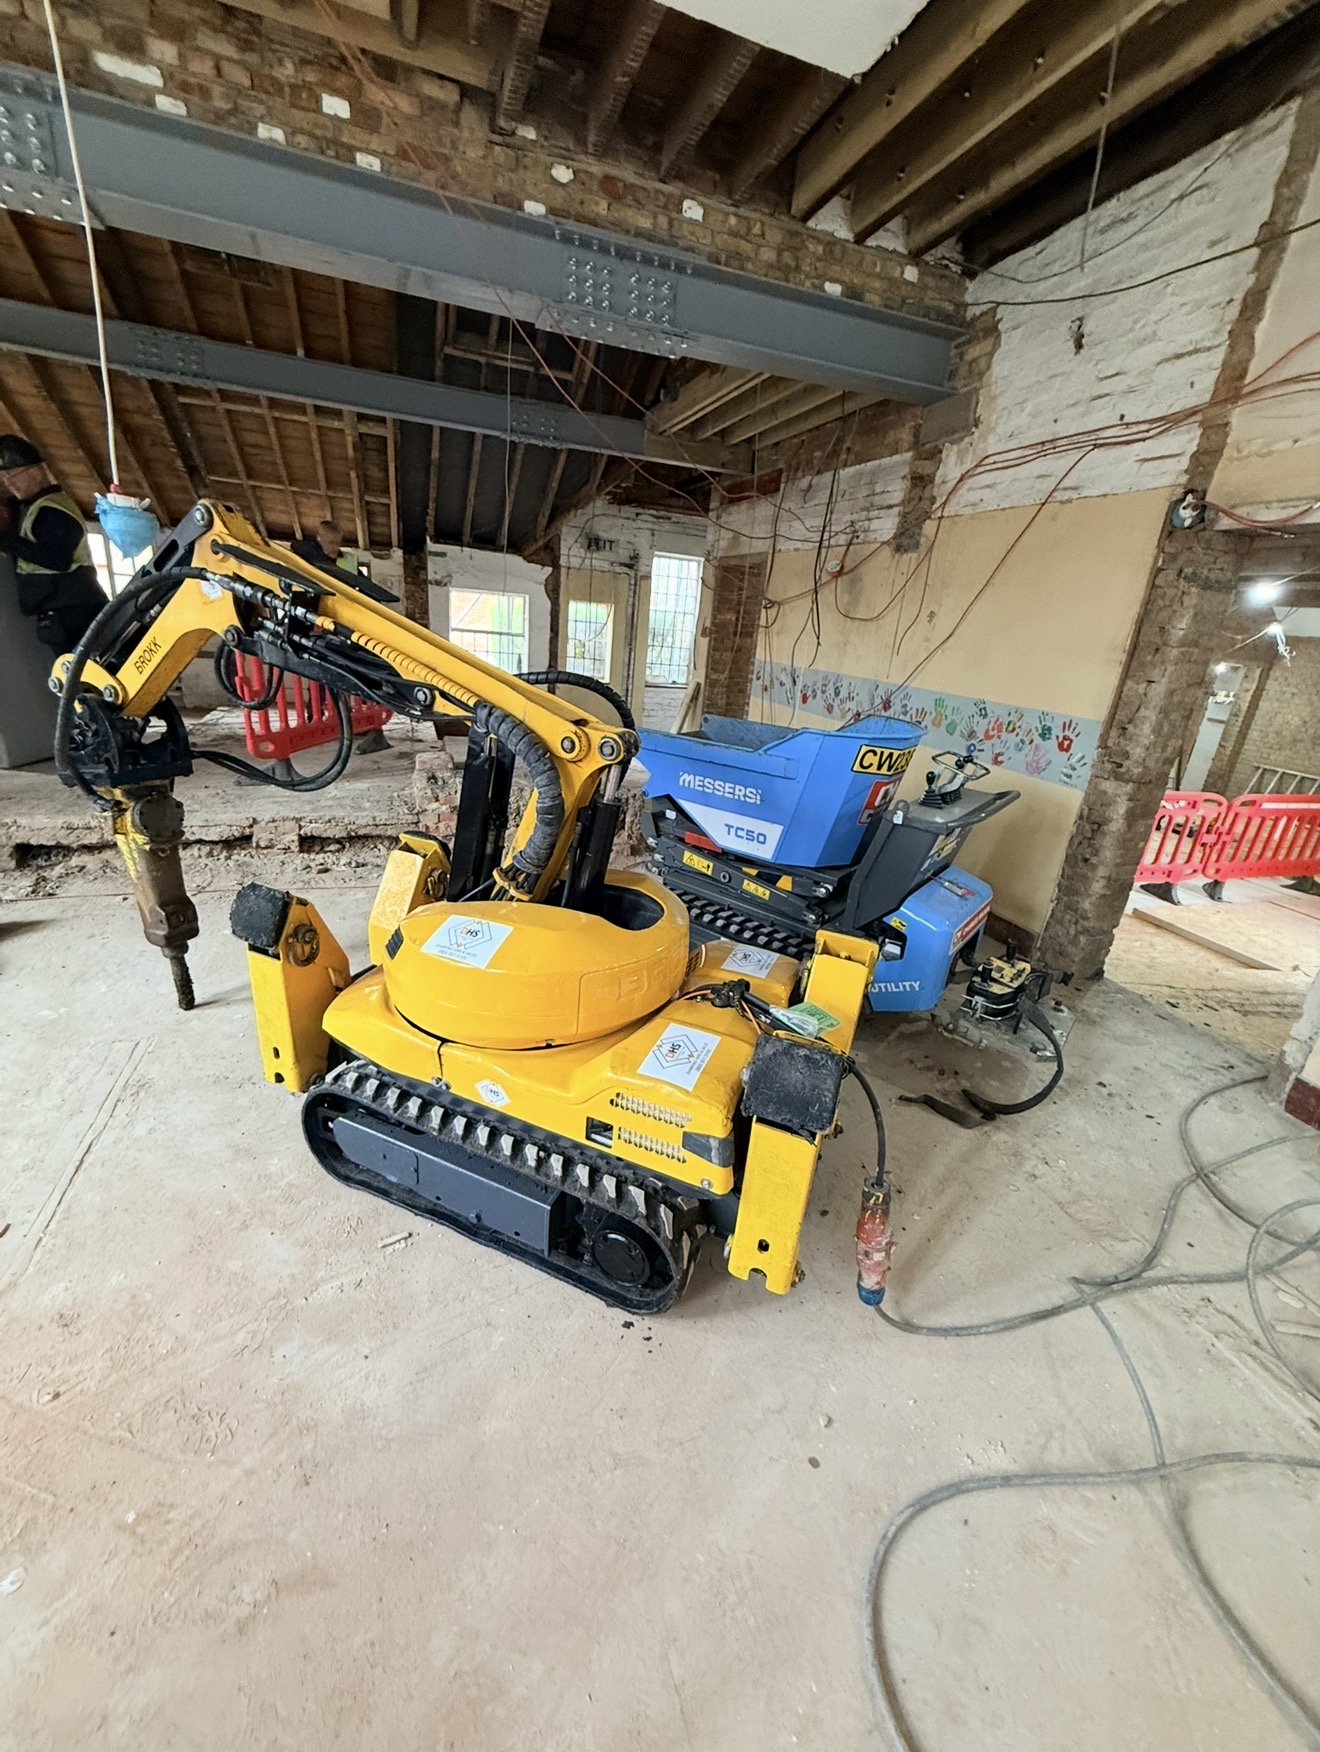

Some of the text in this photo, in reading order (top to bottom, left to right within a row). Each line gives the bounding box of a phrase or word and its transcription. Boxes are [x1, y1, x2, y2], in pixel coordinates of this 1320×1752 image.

[134, 636, 162, 674] BROKK
[724, 823, 767, 846] TC50
[460, 927, 481, 938] DHS
[665, 1042, 682, 1059] DHS
